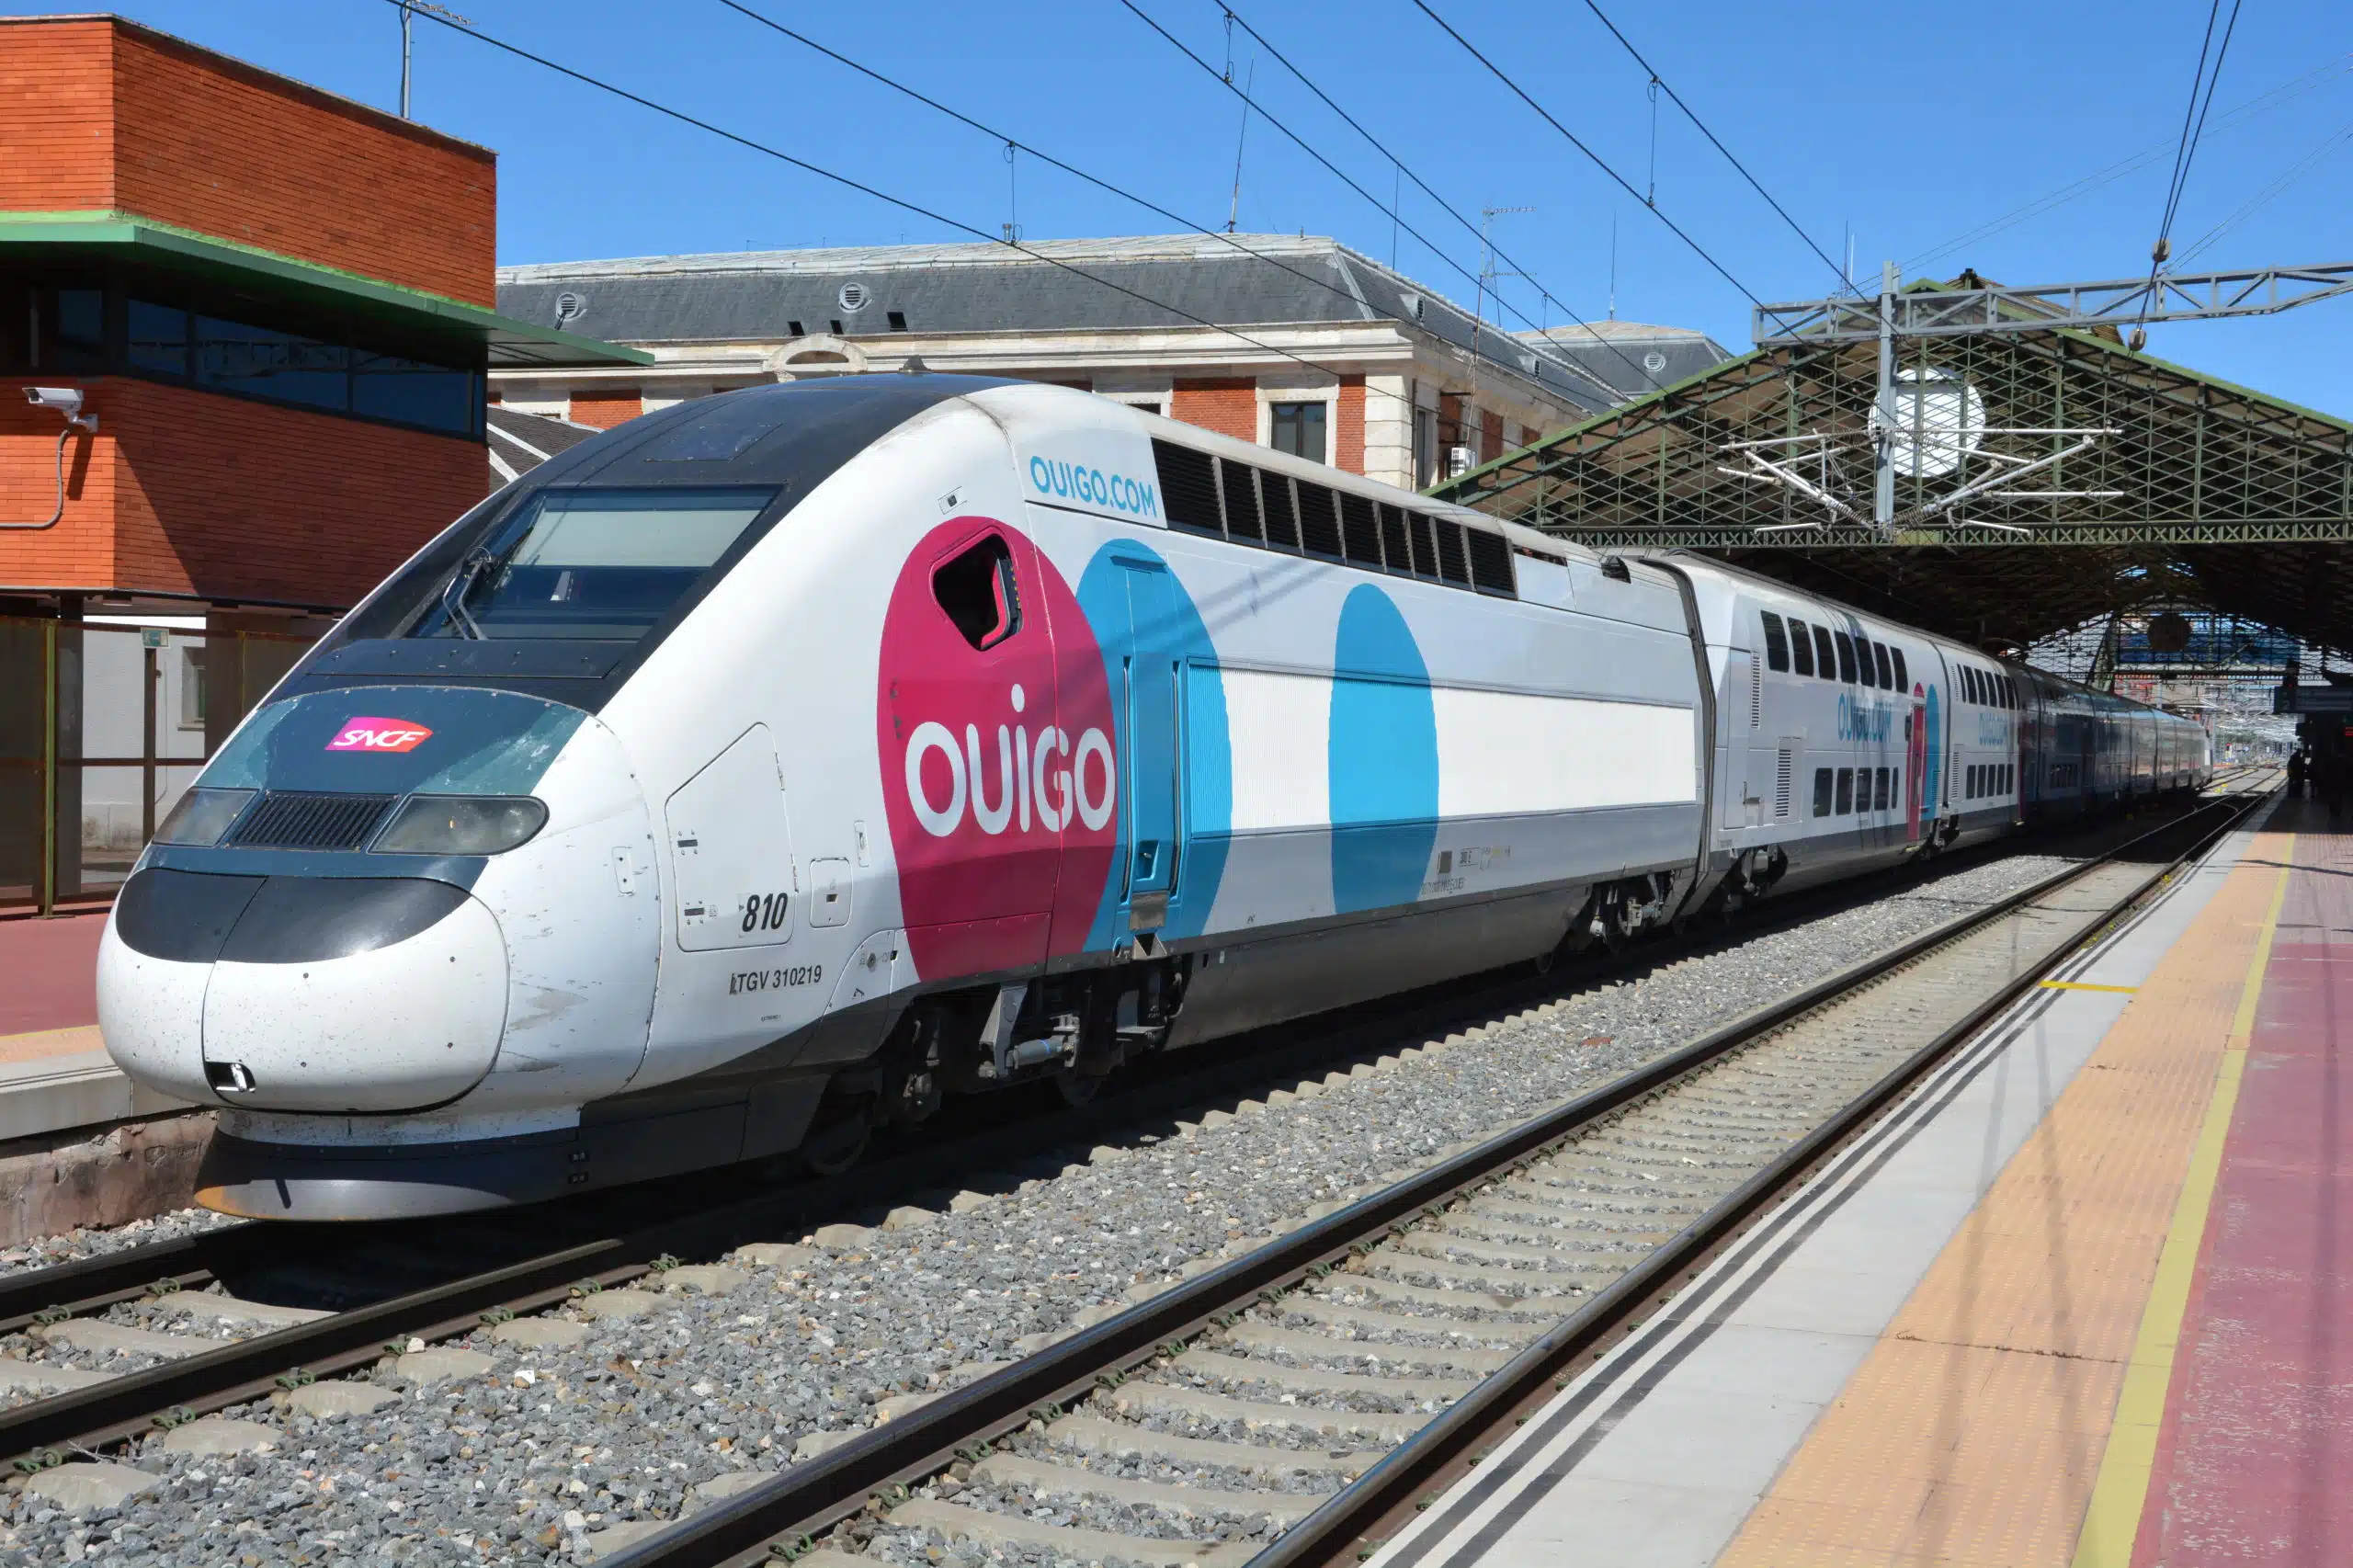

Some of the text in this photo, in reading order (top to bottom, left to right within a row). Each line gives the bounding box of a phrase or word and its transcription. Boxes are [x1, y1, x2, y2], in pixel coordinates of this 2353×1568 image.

[1029, 455, 1157, 518] OUIGO.COM
[333, 730, 426, 747] SNCF
[742, 892, 789, 933] 810
[772, 965, 822, 989] 310219
